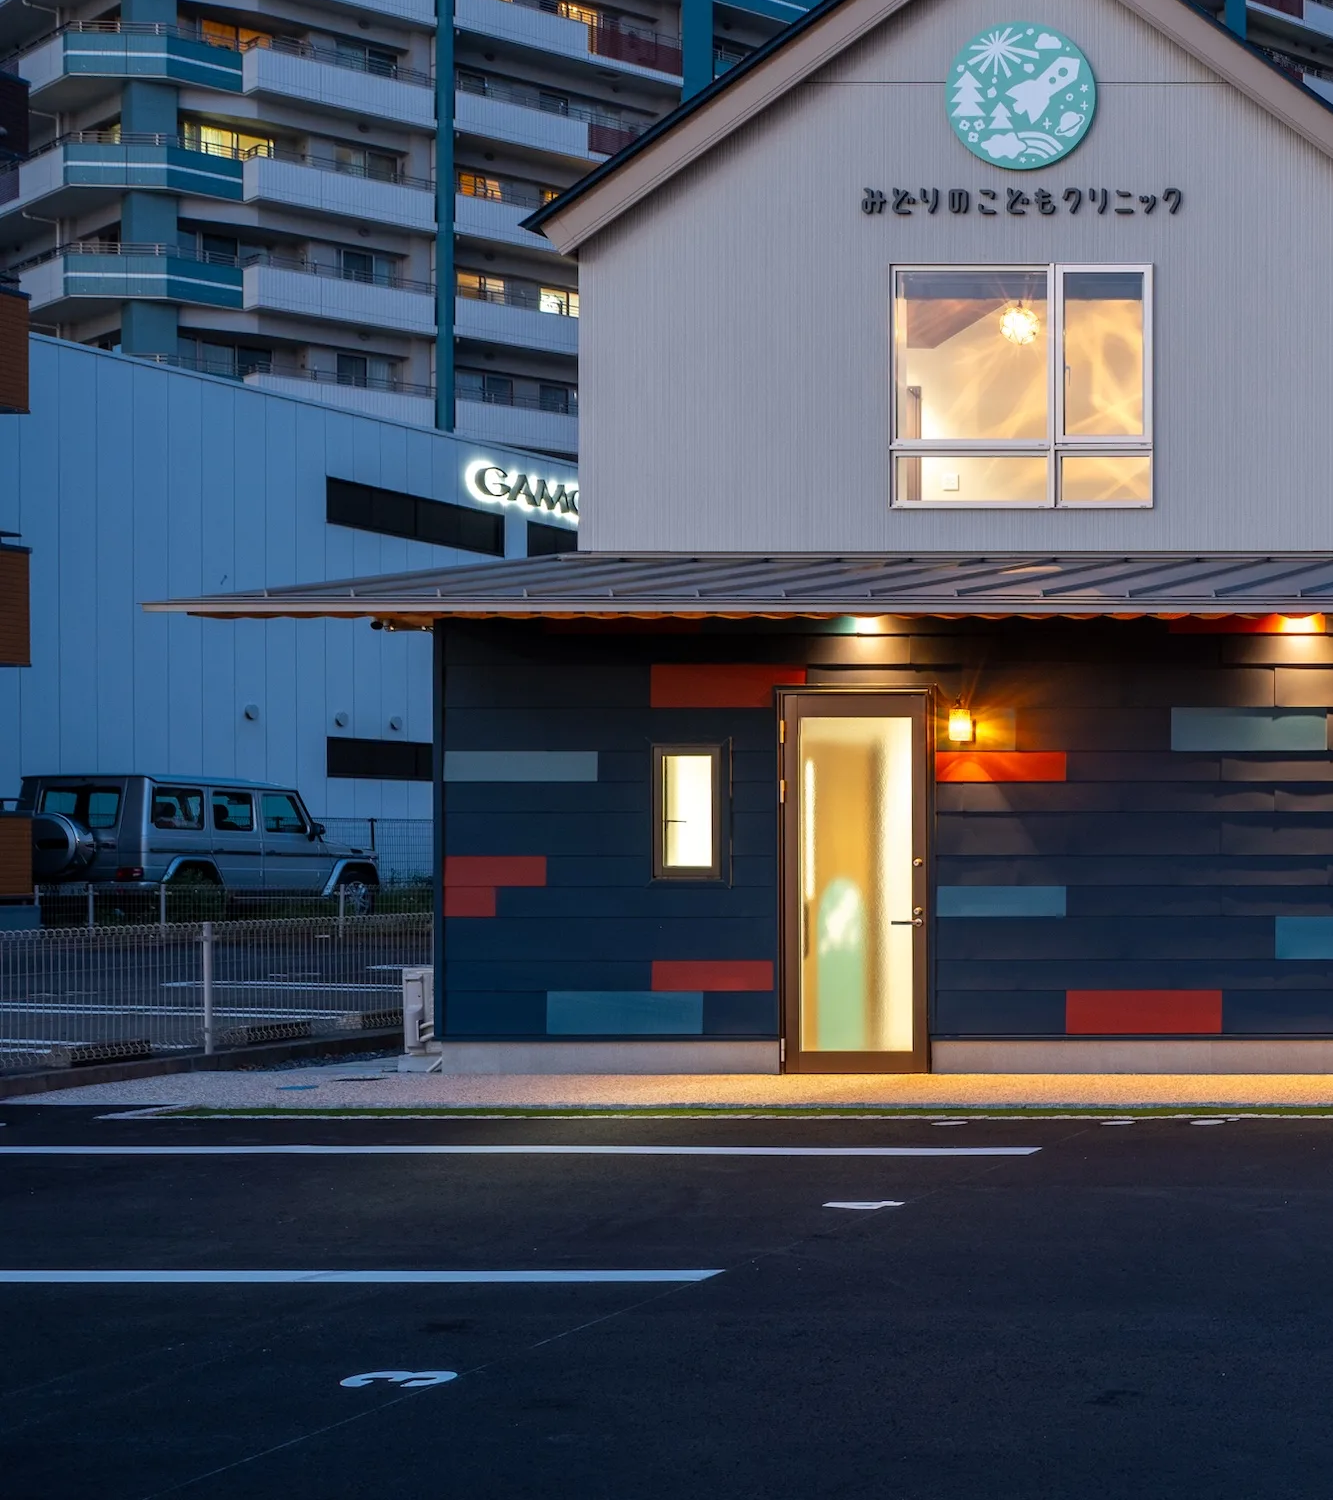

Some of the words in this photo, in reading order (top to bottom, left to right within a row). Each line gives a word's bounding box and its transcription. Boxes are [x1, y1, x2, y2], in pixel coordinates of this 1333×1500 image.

[861, 187, 1182, 214] みどりのこどもクリニック
[340, 1370, 458, 1388] 3
